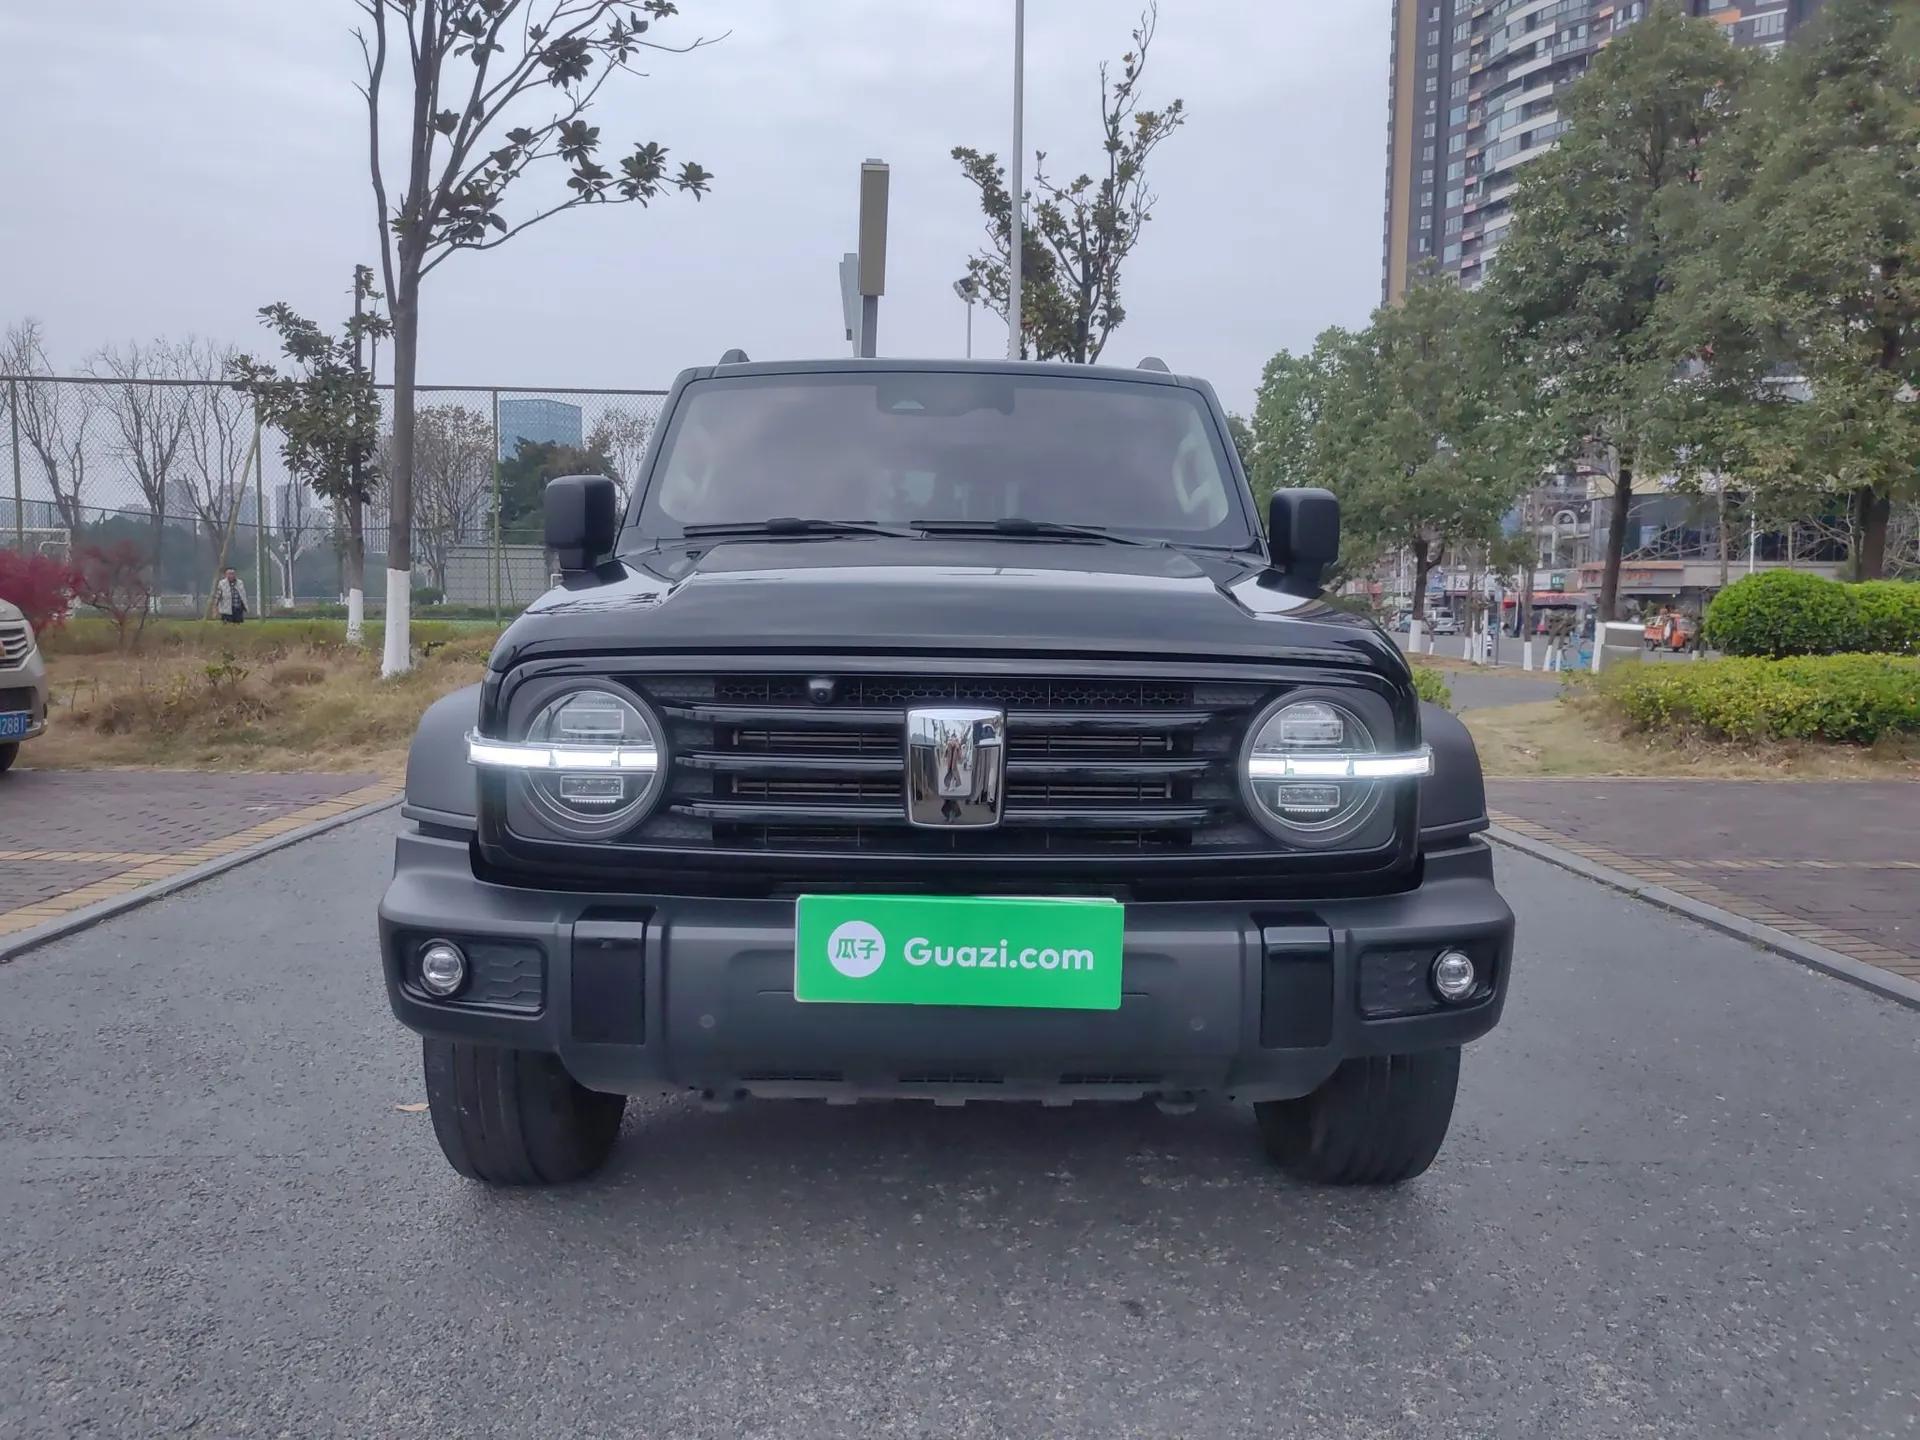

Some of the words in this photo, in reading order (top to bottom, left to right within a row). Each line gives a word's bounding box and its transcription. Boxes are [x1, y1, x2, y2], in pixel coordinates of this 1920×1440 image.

[0, 717, 24, 734] 2881
[835, 938, 879, 960] 瓜子
[904, 937, 1094, 970] Guazi.com
